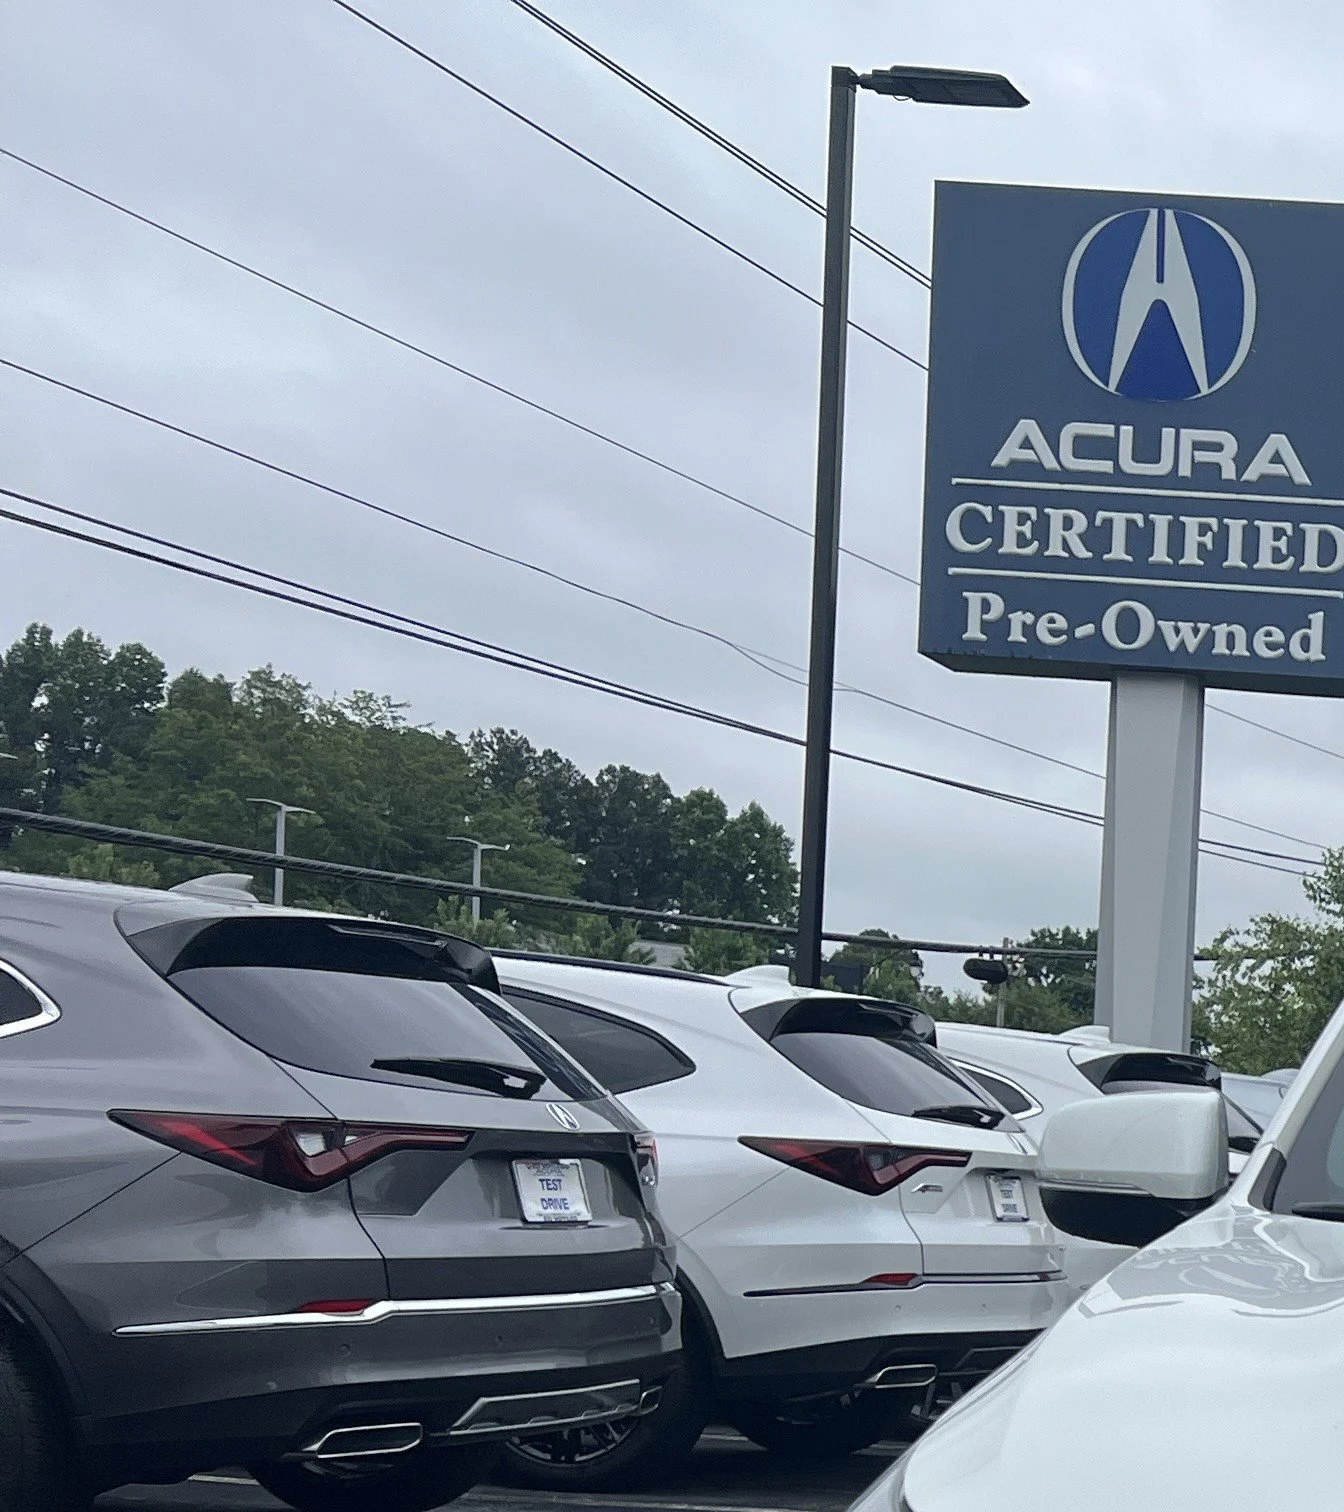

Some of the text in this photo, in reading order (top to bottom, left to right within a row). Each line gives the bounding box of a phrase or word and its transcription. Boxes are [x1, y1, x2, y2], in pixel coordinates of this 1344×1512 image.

[990, 418, 1312, 486] ACURA
[961, 590, 1327, 663] Pre-Owned
[538, 1178, 563, 1191] TEST
[540, 1197, 571, 1211] DRIVE
